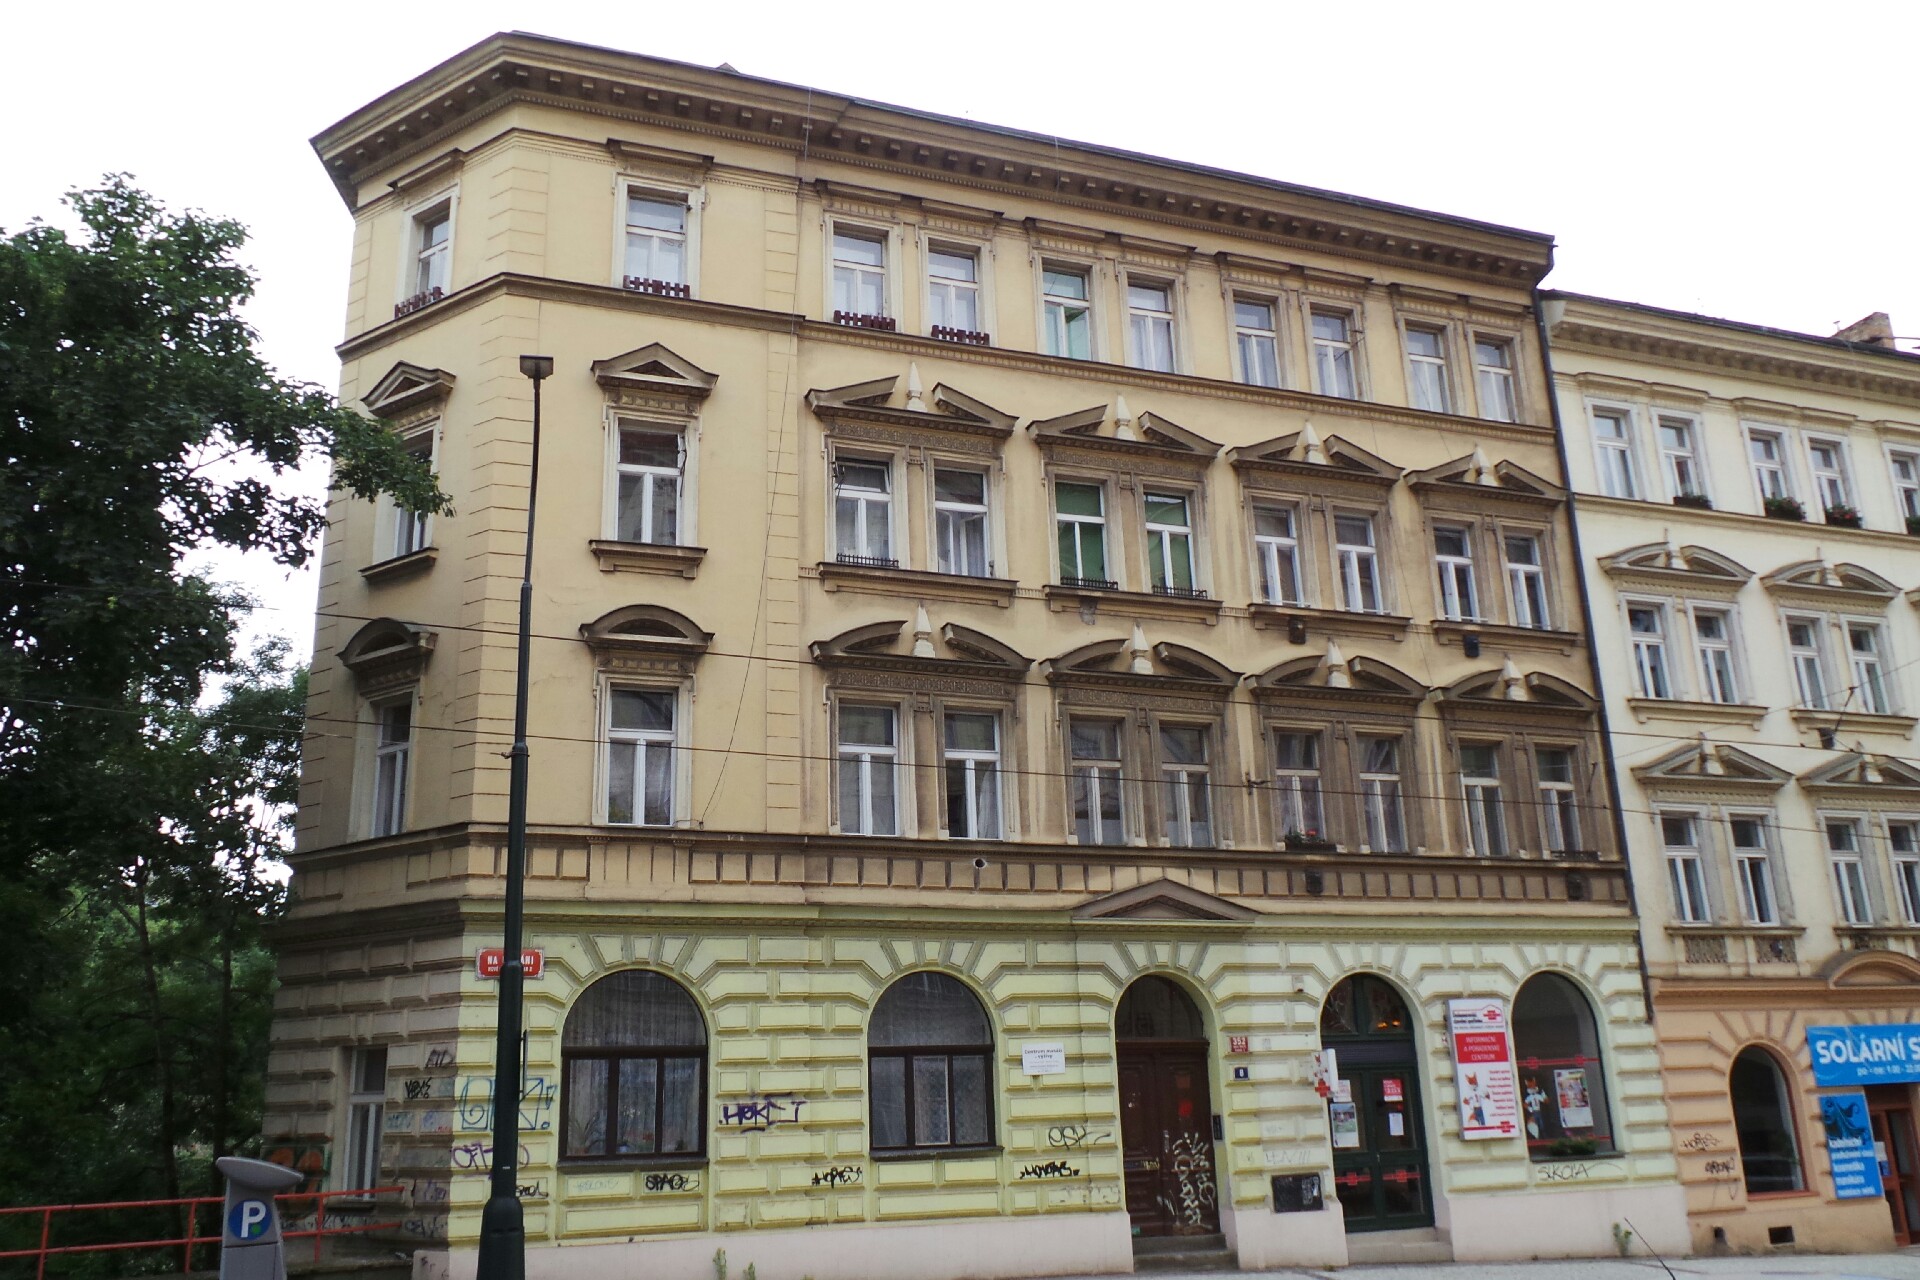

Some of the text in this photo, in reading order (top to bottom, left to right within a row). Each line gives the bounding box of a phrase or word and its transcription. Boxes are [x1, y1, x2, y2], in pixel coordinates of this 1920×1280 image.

[488, 955, 498, 965] NA
[1232, 1036, 1246, 1045] 352
[1815, 1031, 1906, 1064] SOLÁRNÍ
[239, 1200, 267, 1239] P
